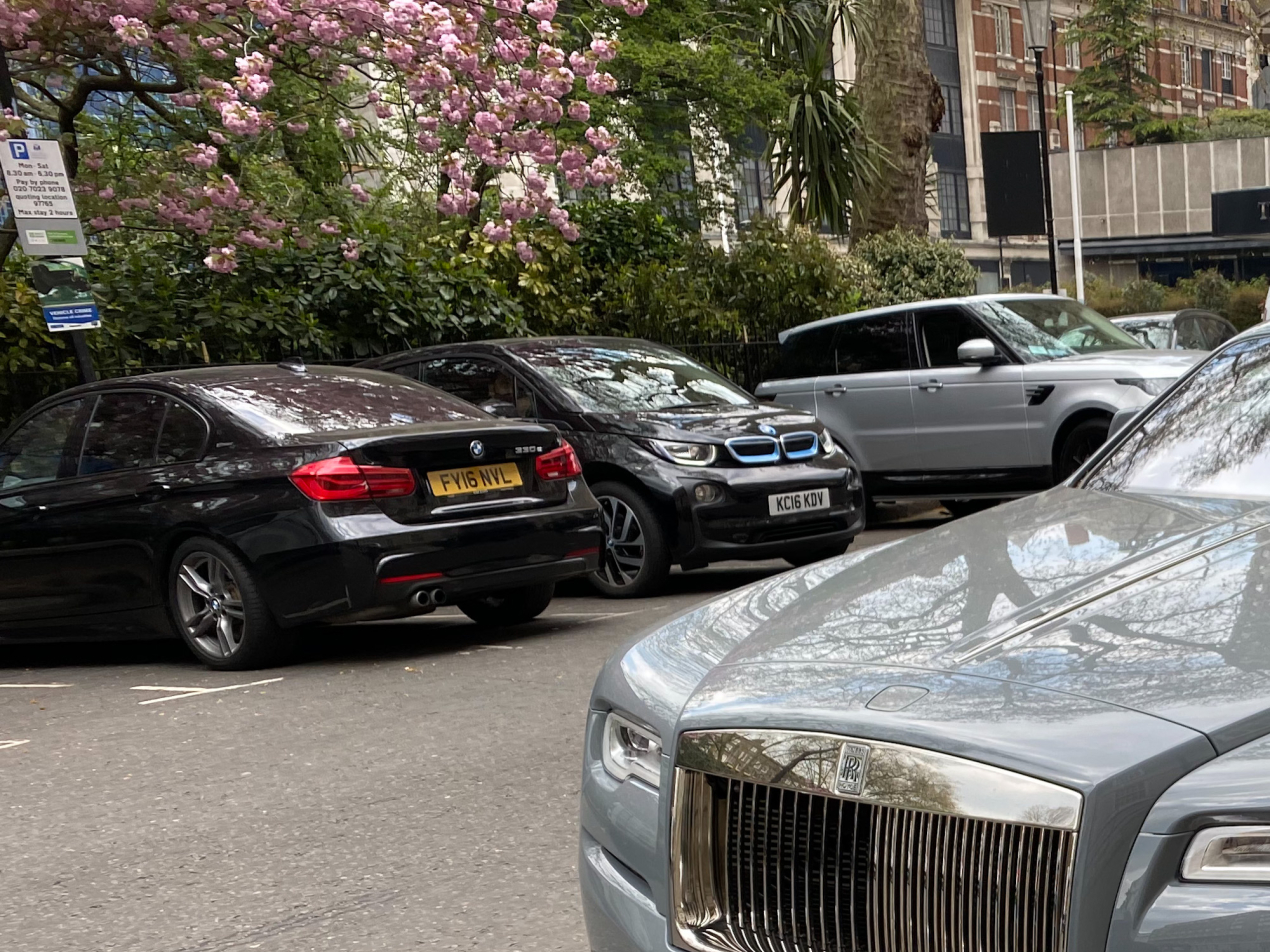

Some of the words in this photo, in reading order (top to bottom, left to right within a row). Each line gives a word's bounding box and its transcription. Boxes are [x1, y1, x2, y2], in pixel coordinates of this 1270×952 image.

[440, 471, 478, 492] FY16
[479, 467, 512, 487] NVL
[776, 494, 801, 512] KC16
[803, 491, 823, 508] KDV
